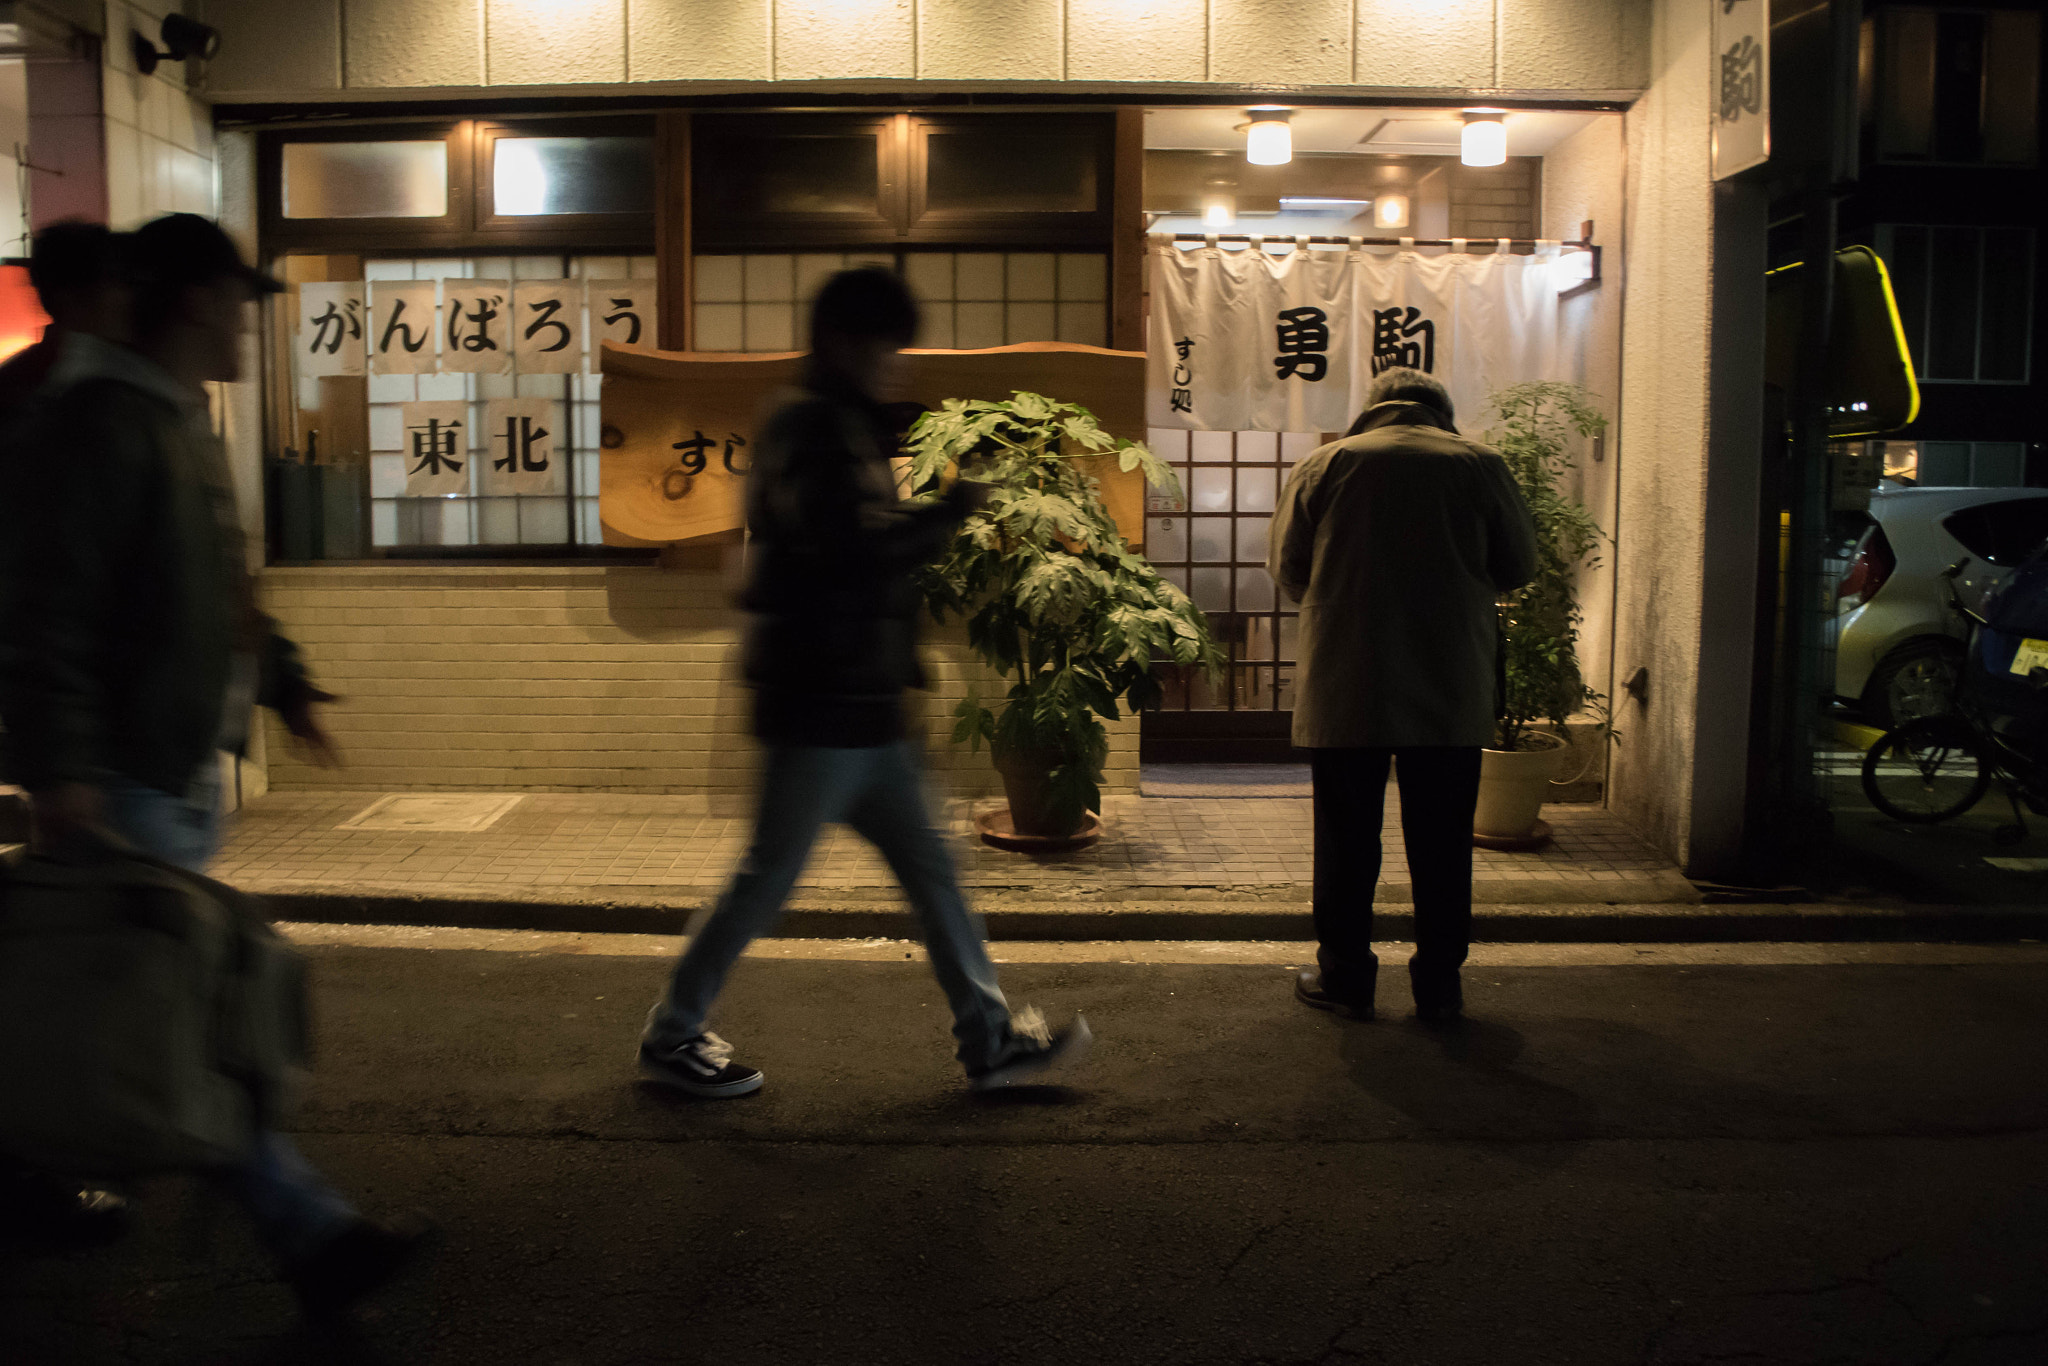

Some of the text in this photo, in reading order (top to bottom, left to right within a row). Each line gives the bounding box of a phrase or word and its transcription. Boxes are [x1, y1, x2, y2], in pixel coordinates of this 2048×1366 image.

[1720, 0, 1763, 123] 駒
[310, 296, 641, 354] がんばろう
[1274, 306, 1435, 382] 勇駒
[1171, 336, 1195, 413] すし処
[407, 416, 549, 476] 東北
